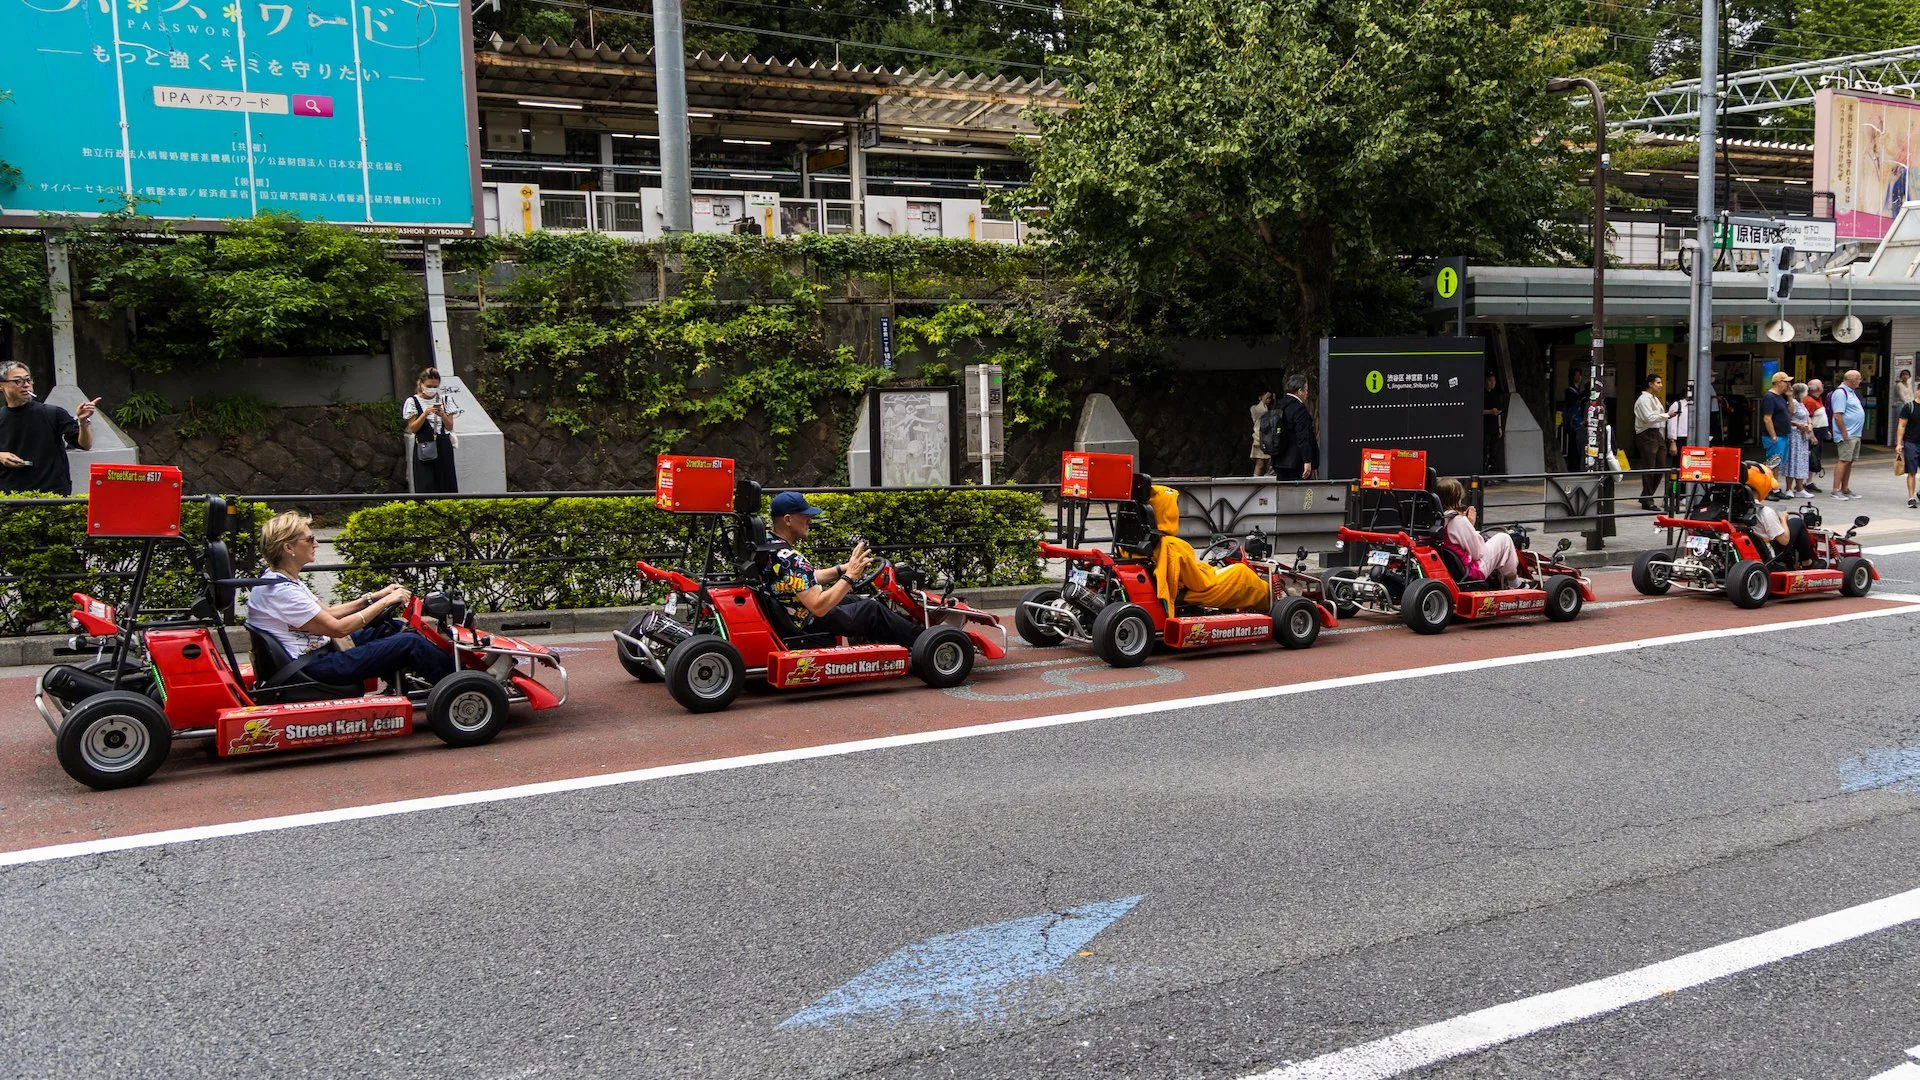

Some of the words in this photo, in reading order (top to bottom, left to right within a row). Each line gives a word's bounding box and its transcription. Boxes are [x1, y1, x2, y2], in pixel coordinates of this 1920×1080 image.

[92, 45, 380, 82] もっと強くキミを守りたい
[161, 91, 191, 104] IPA
[199, 94, 270, 109] パスワード
[428, 228, 464, 236] JOYBOARD
[1425, 373, 1439, 381] 1-18
[1413, 382, 1429, 390] Shibuya
[107, 469, 146, 481] StreetKart.com
[146, 472, 162, 482] #517
[1499, 601, 1518, 611] Street
[1518, 600, 1531, 609] Kart
[1211, 627, 1235, 640] Street
[1235, 626, 1251, 638] Kart
[1251, 625, 1269, 636] .com
[824, 662, 857, 676] Street
[859, 659, 879, 673] Kart
[881, 658, 905, 670] .com
[285, 723, 333, 740] Street
[335, 719, 367, 735] Kart
[370, 716, 405, 731] .com
